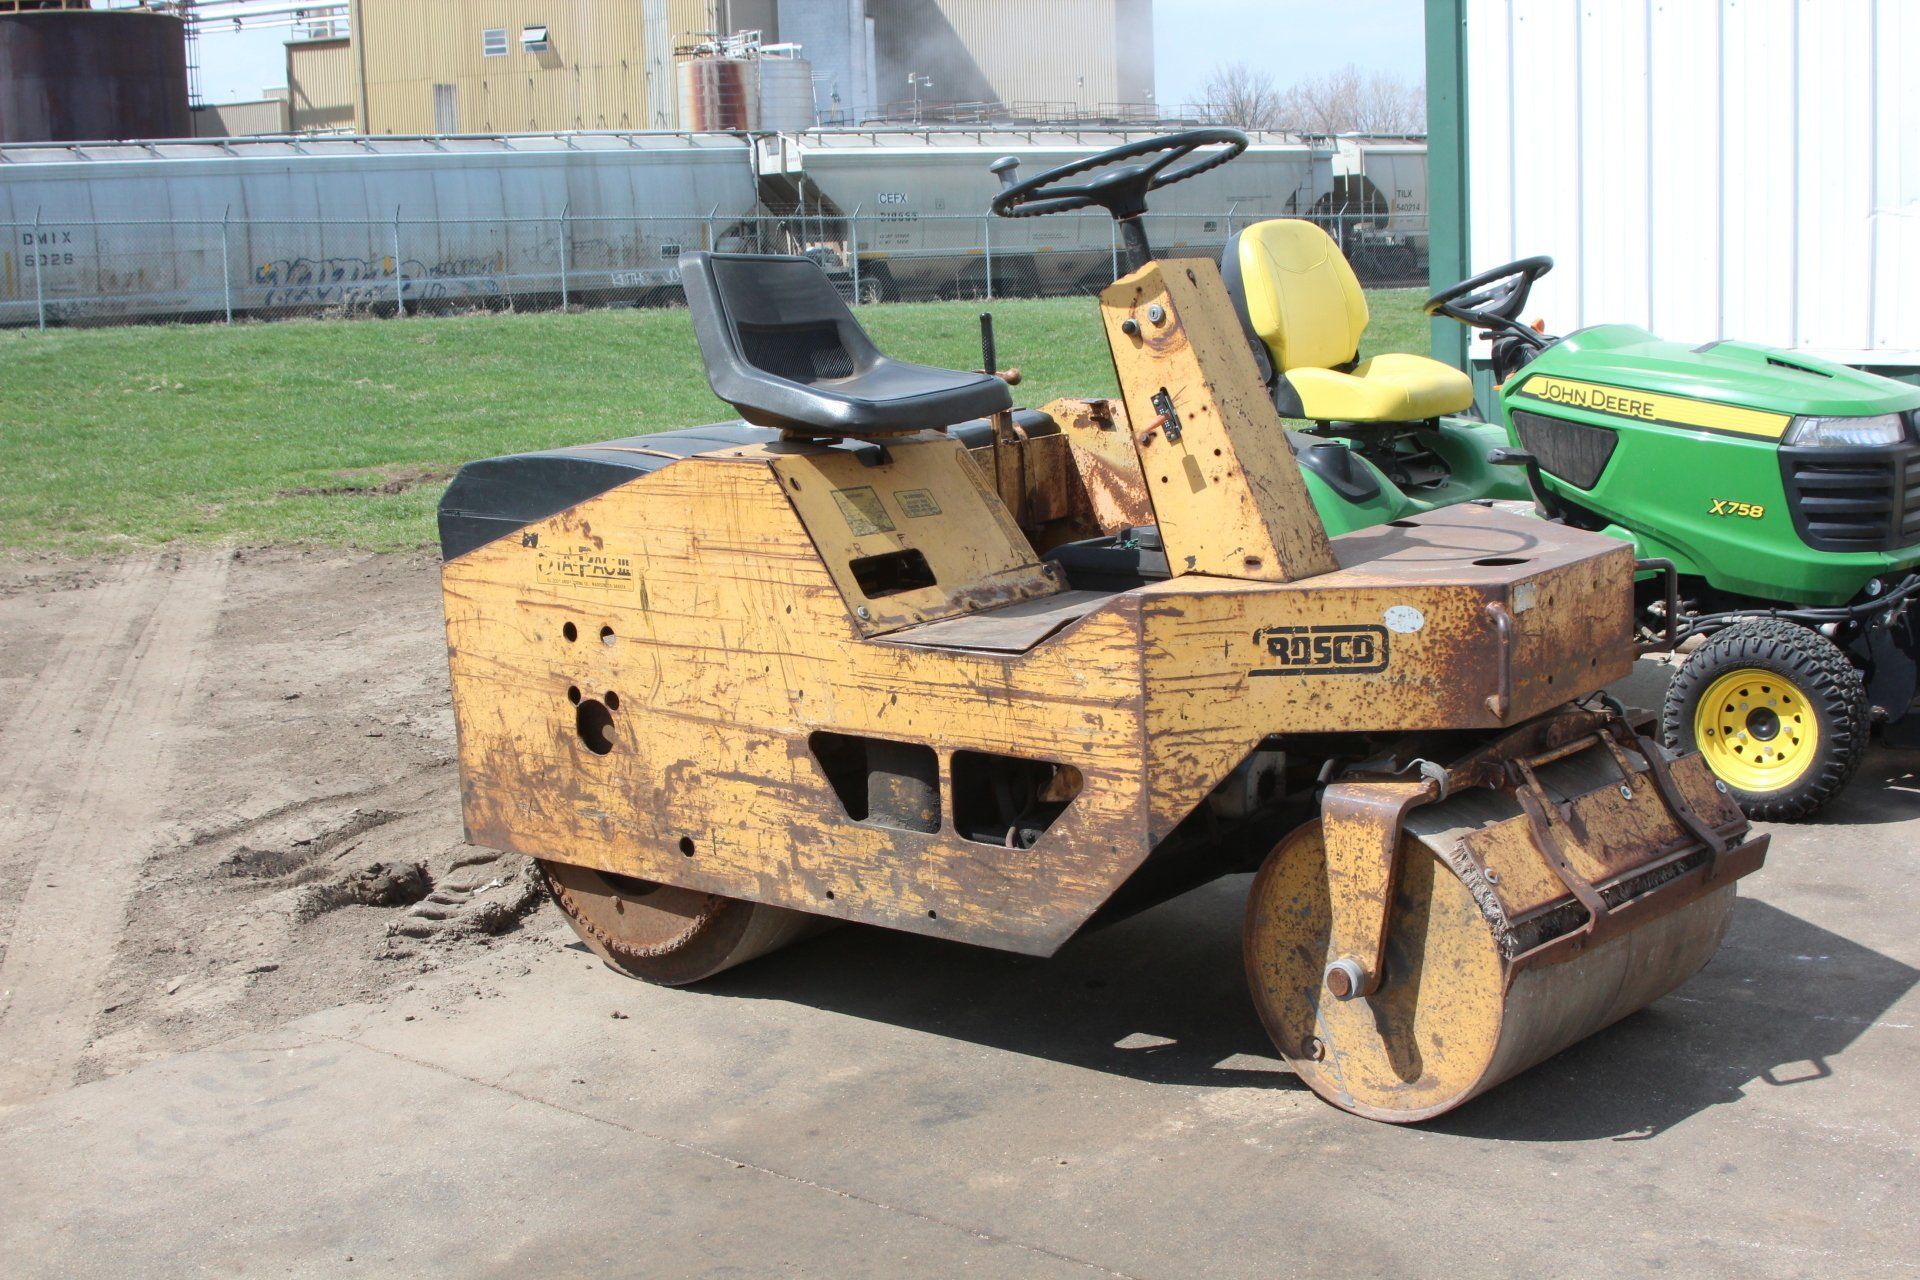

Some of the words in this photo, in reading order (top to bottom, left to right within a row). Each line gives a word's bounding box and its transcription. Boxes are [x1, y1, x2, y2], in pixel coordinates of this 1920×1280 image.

[879, 193, 907, 204] CEFX
[23, 232, 71, 246] DMIX
[1539, 380, 1587, 404] JOHN
[1591, 389, 1655, 417] DEERE
[1708, 499, 1764, 518] X758
[1267, 635, 1375, 665] ROSCO
